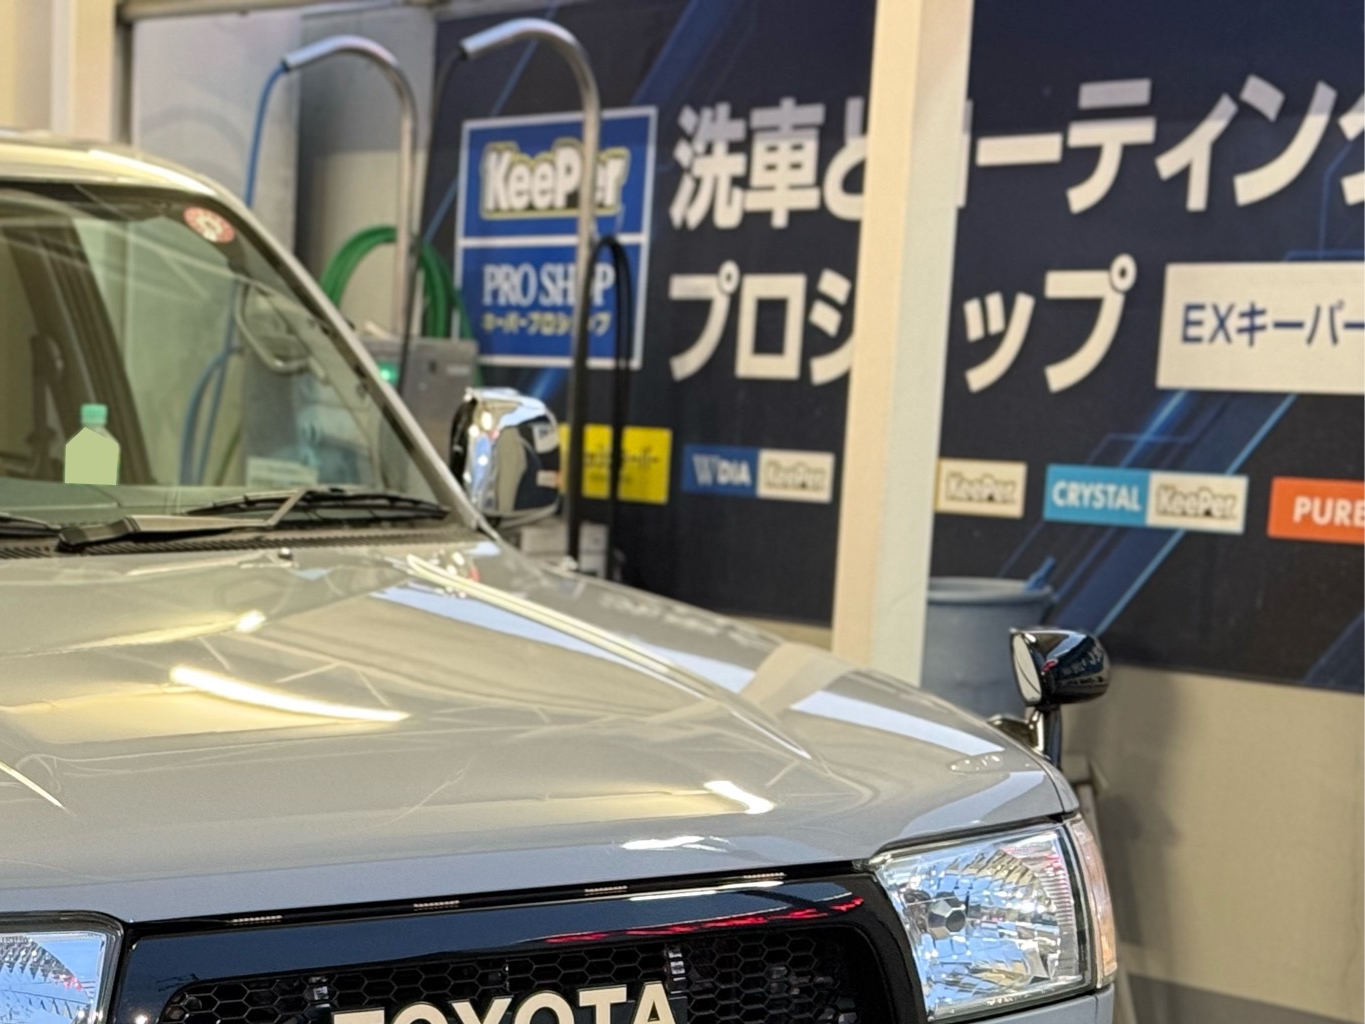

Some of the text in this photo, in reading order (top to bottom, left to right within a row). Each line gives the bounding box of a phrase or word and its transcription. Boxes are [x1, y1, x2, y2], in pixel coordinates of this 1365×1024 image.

[670, 74, 1365, 229] 洗車とーティン
[483, 262, 616, 307] PRO SHP
[669, 254, 1137, 392] プロシップ
[1051, 480, 1141, 513] CRYSTAL
